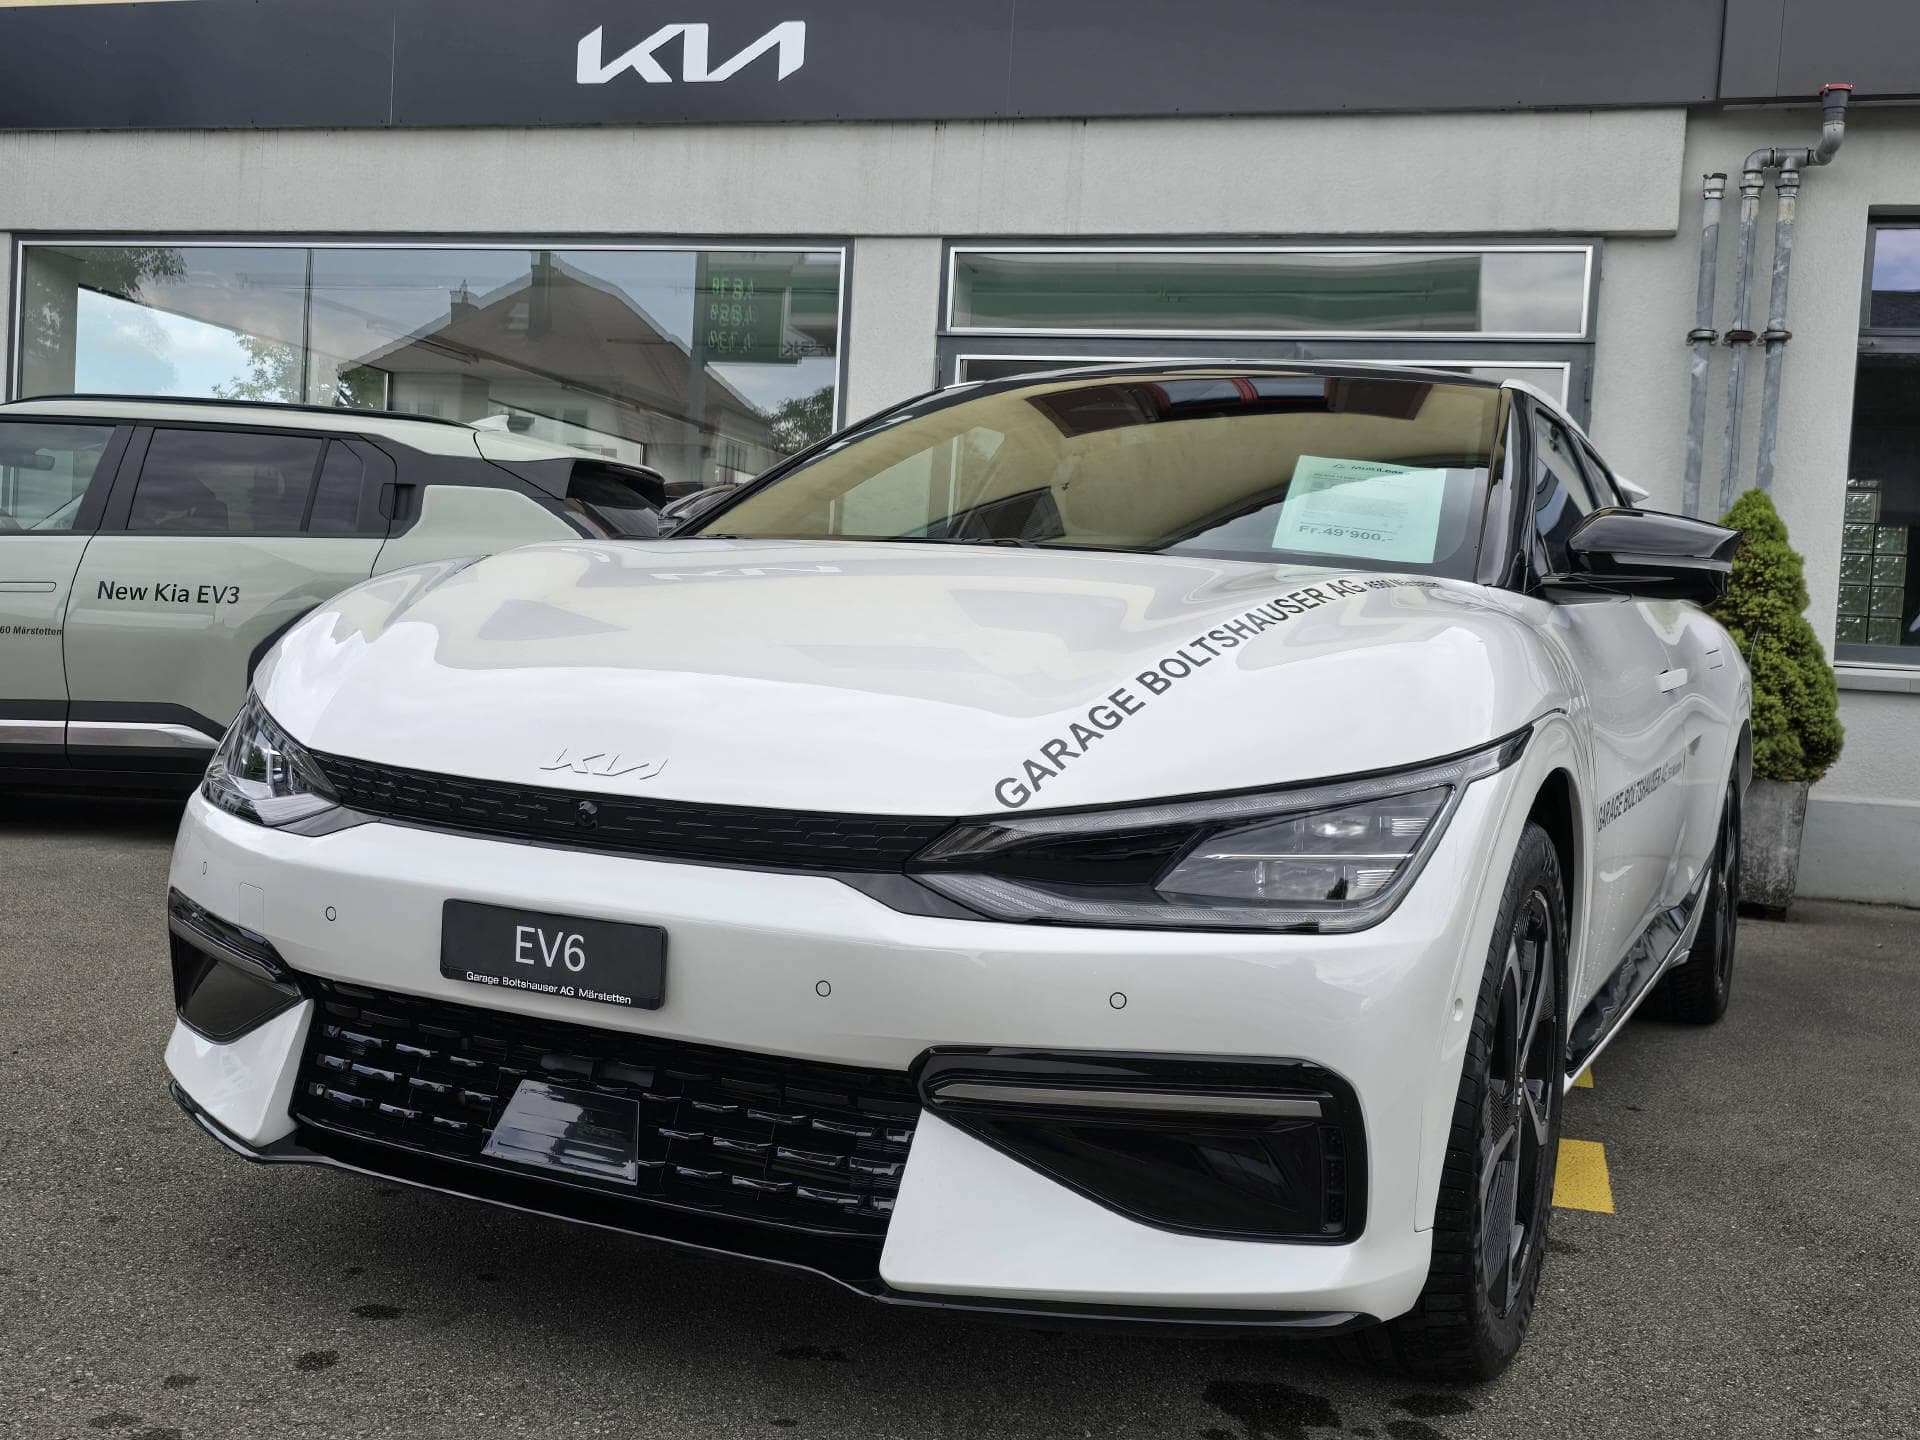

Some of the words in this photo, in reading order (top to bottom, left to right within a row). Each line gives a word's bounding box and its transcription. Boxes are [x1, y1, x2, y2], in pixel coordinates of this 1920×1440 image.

[577, 20, 806, 84] KIA
[97, 580, 148, 601] New
[154, 583, 190, 602] Kia
[197, 585, 240, 604] EV3
[13, 625, 63, 636] Märstetten
[994, 687, 1146, 809] GARAGE
[1135, 587, 1336, 696] BOLTSHAUSER
[1326, 579, 1367, 598] AG
[539, 747, 669, 781] KIA
[1598, 791, 1624, 833] GARAGE
[515, 925, 586, 972] EV6
[466, 971, 500, 985] Garage
[502, 976, 558, 993] Boltshauser
[559, 986, 575, 996] AG
[578, 988, 632, 1004] Märstetten
